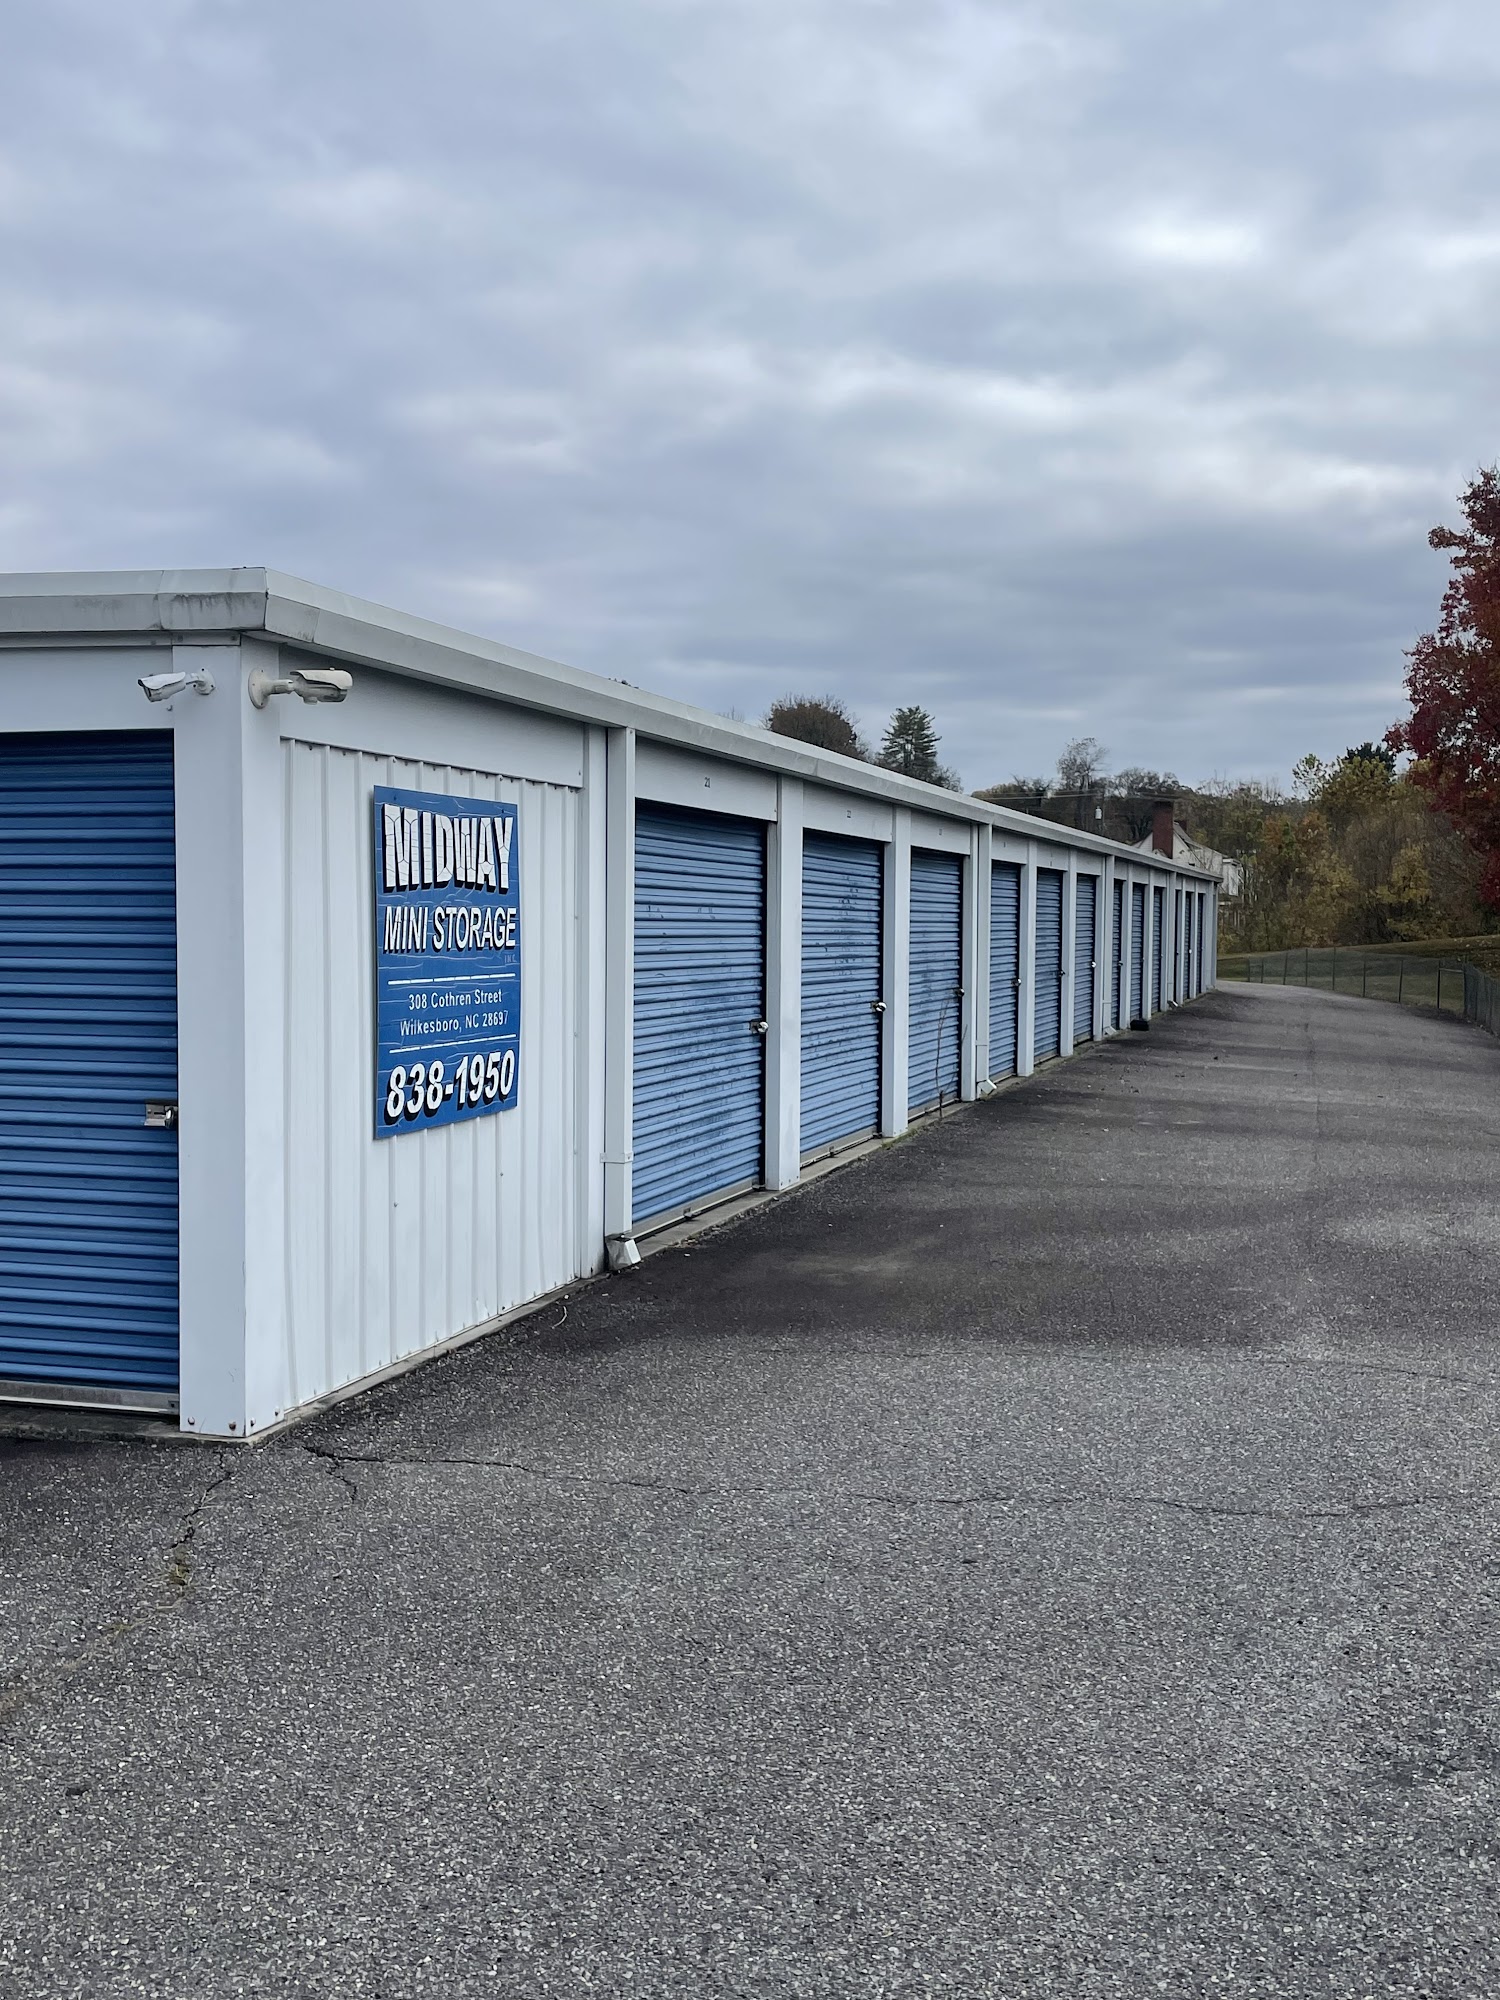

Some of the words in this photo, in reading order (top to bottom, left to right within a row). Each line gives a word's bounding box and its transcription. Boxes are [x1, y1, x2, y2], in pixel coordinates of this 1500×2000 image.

[383, 803, 514, 893] MIDWAY
[383, 906, 429, 953] MINI
[432, 906, 517, 951] STORAGE
[408, 993, 428, 1010] 308
[431, 991, 472, 1008] Cothren
[474, 988, 503, 1005] Street
[400, 1018, 462, 1037] Wilkesboro,
[465, 1013, 480, 1029] NC
[482, 1010, 509, 1027] 28697
[384, 1049, 516, 1125] 838-1950
